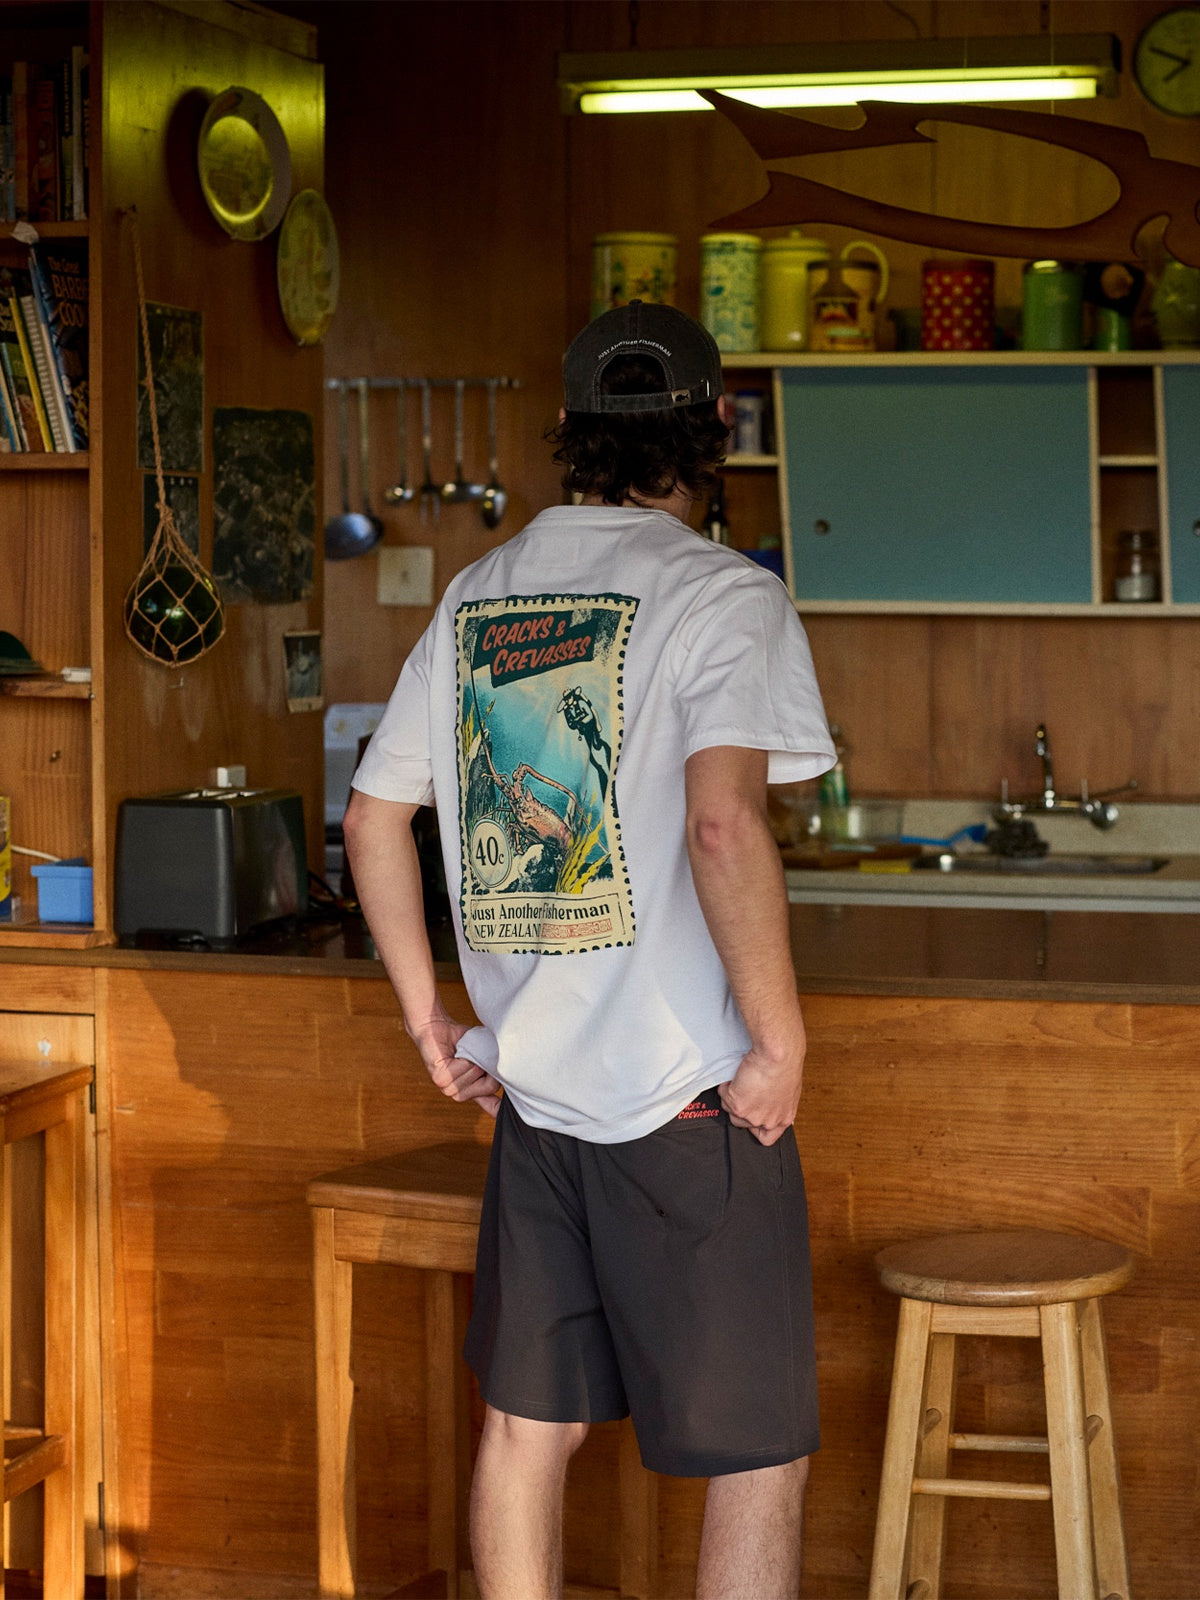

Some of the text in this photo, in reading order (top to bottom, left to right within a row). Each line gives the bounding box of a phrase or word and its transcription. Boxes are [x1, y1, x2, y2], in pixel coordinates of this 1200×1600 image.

[638, 339, 672, 357] FISHERMAN
[482, 615, 567, 651] CRACKS &
[492, 635, 592, 676] CREVASSES
[472, 907, 495, 921] Just
[500, 903, 542, 919] Another
[474, 923, 542, 938] NEW ZEALAN
